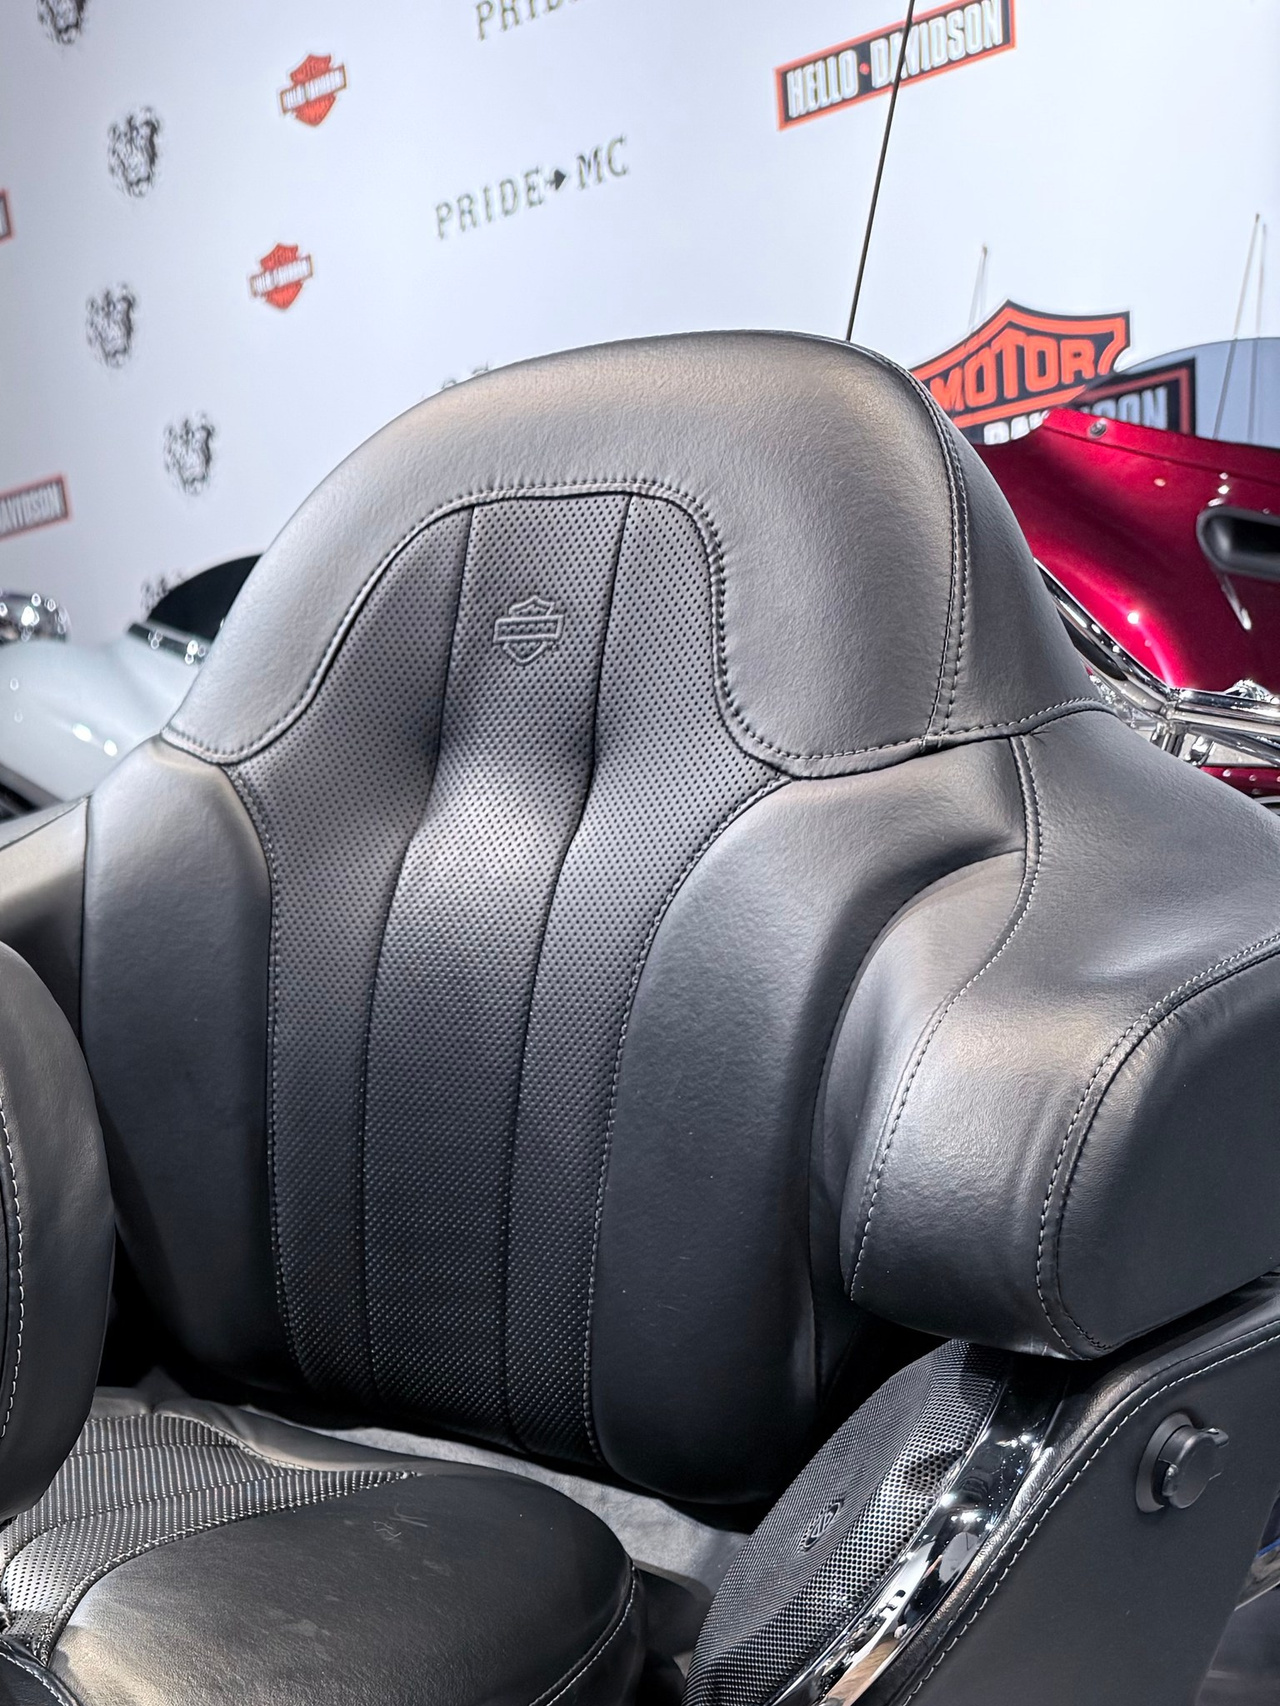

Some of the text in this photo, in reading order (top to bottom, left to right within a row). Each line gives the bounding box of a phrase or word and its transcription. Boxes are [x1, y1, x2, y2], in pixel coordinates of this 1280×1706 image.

[786, 0, 1004, 119] HELLO DAVIDSON
[435, 134, 630, 240] PRIDE MC
[929, 327, 1096, 412] MOTOR
